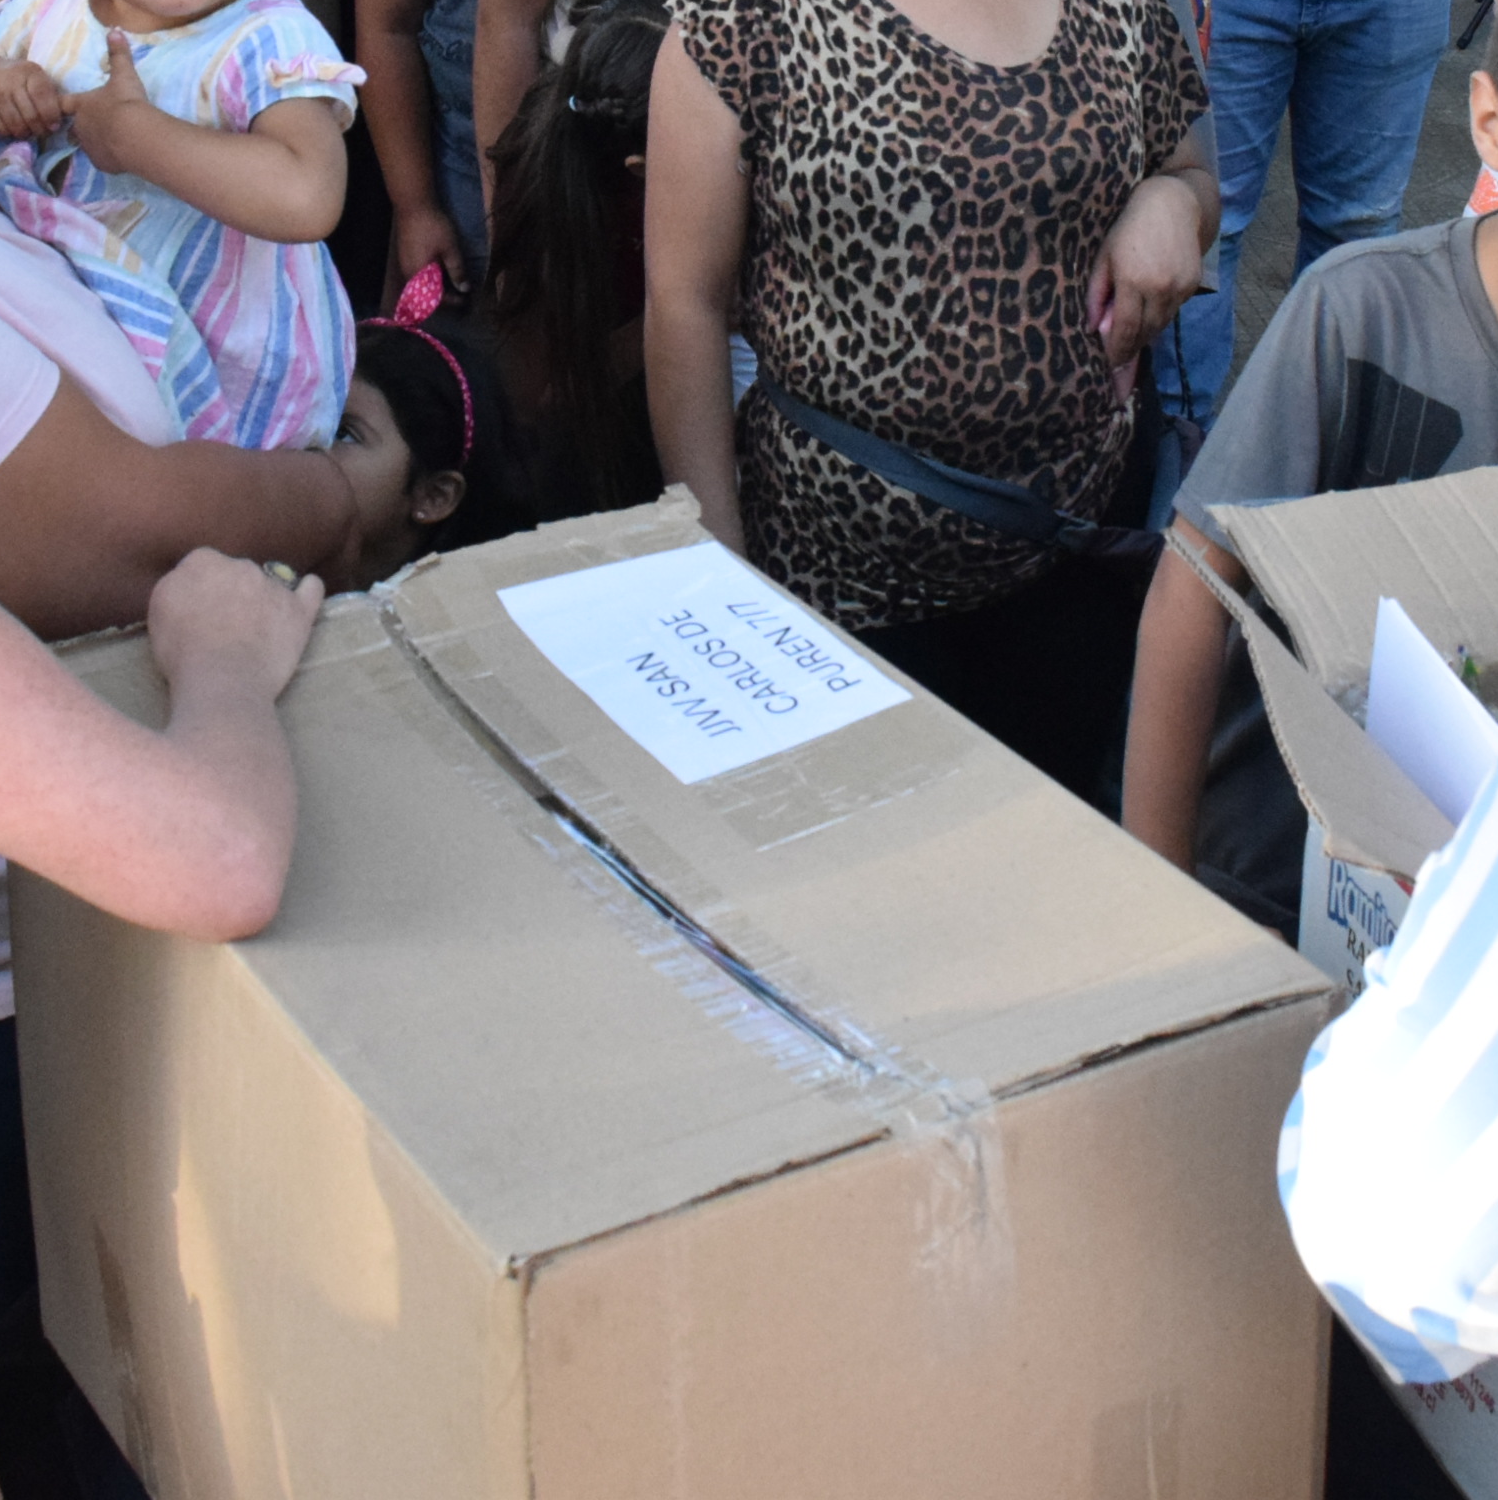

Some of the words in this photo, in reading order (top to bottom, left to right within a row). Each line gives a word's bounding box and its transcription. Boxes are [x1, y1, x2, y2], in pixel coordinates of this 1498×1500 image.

[658, 609, 707, 640] DE
[627, 651, 691, 698] SAN
[693, 638, 799, 714] CARLOS
[763, 625, 862, 693] PUREN
